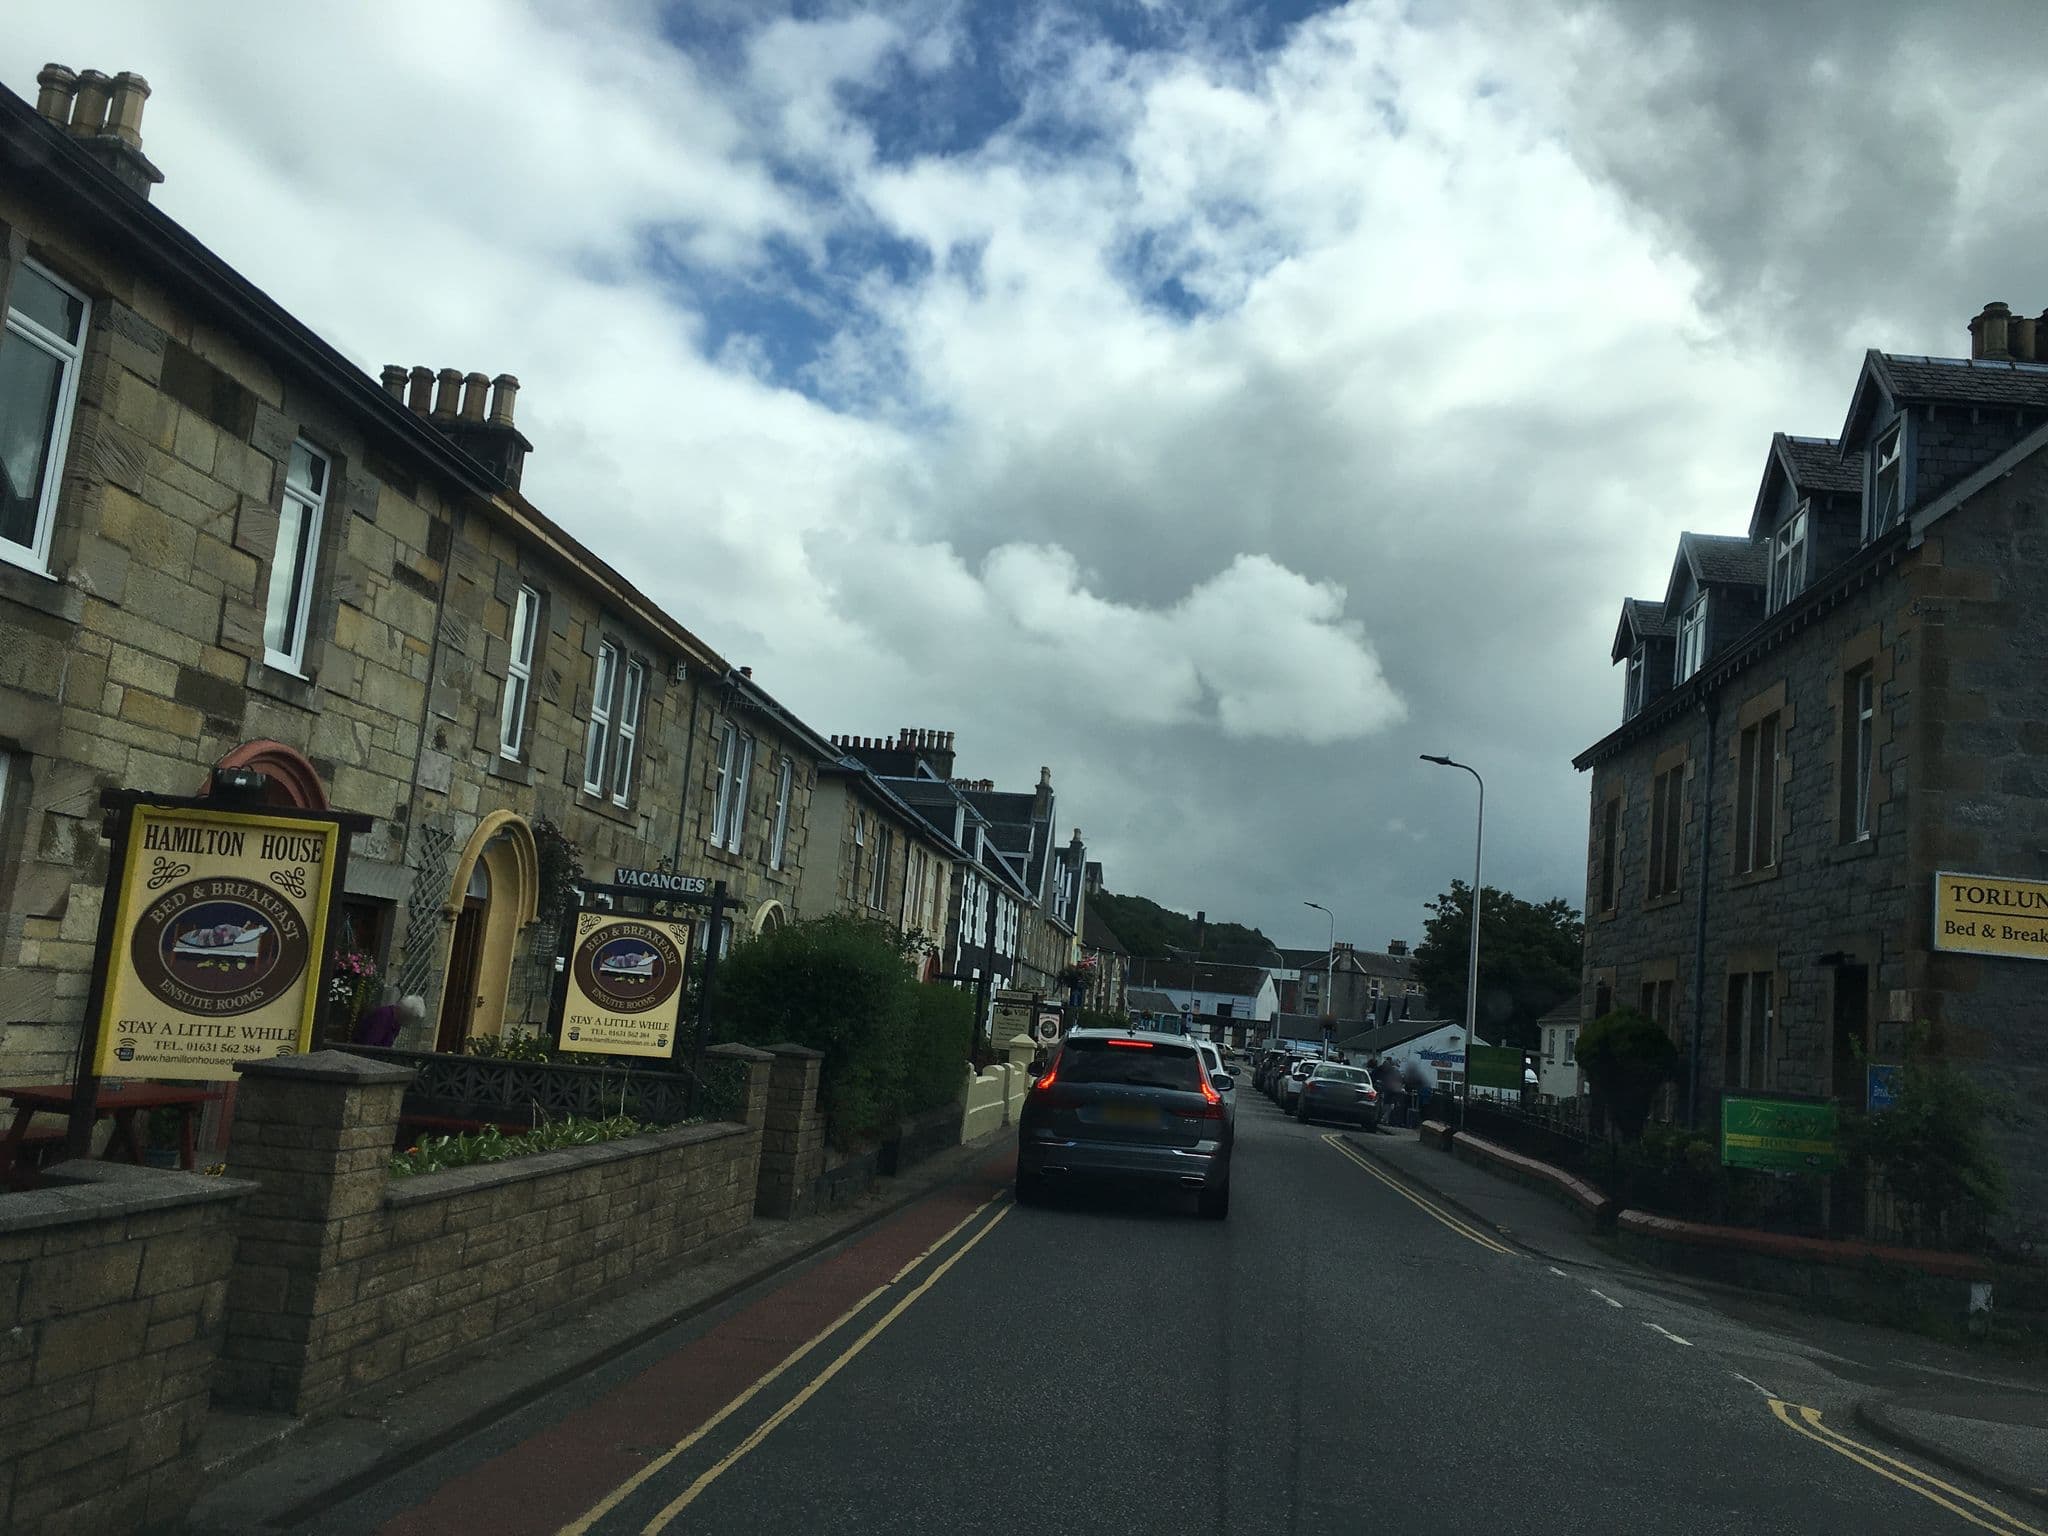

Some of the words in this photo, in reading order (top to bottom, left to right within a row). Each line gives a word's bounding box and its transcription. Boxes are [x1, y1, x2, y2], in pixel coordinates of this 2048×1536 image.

[143, 823, 246, 857] HAMILTON
[260, 833, 324, 864] HOUSE
[616, 869, 706, 893] VACANCIES
[149, 890, 187, 926] BED
[192, 884, 206, 900] &
[210, 882, 301, 943] BREAKFAST
[1945, 920, 1976, 937] Bed
[1981, 924, 1996, 939] &
[586, 931, 610, 953] BED
[611, 926, 621, 937] &
[623, 925, 678, 965] BREAKFAST
[159, 977, 213, 1010] ENSUITE
[216, 986, 265, 1011] ROOMS
[591, 986, 626, 1010] ENSUITE
[626, 994, 656, 1010] ROOMS
[117, 1020, 158, 1035] STAY
[161, 1022, 174, 1036] A
[178, 1023, 237, 1040] LITTLE
[241, 1025, 298, 1043] WHILE
[569, 1015, 593, 1025] STAY
[604, 1018, 637, 1030] LITTLE
[639, 1020, 670, 1032] WHILE
[154, 1039, 184, 1053] TEL.
[186, 1041, 218, 1054] 01631
[220, 1043, 241, 1055] 562
[242, 1044, 262, 1056] 384
